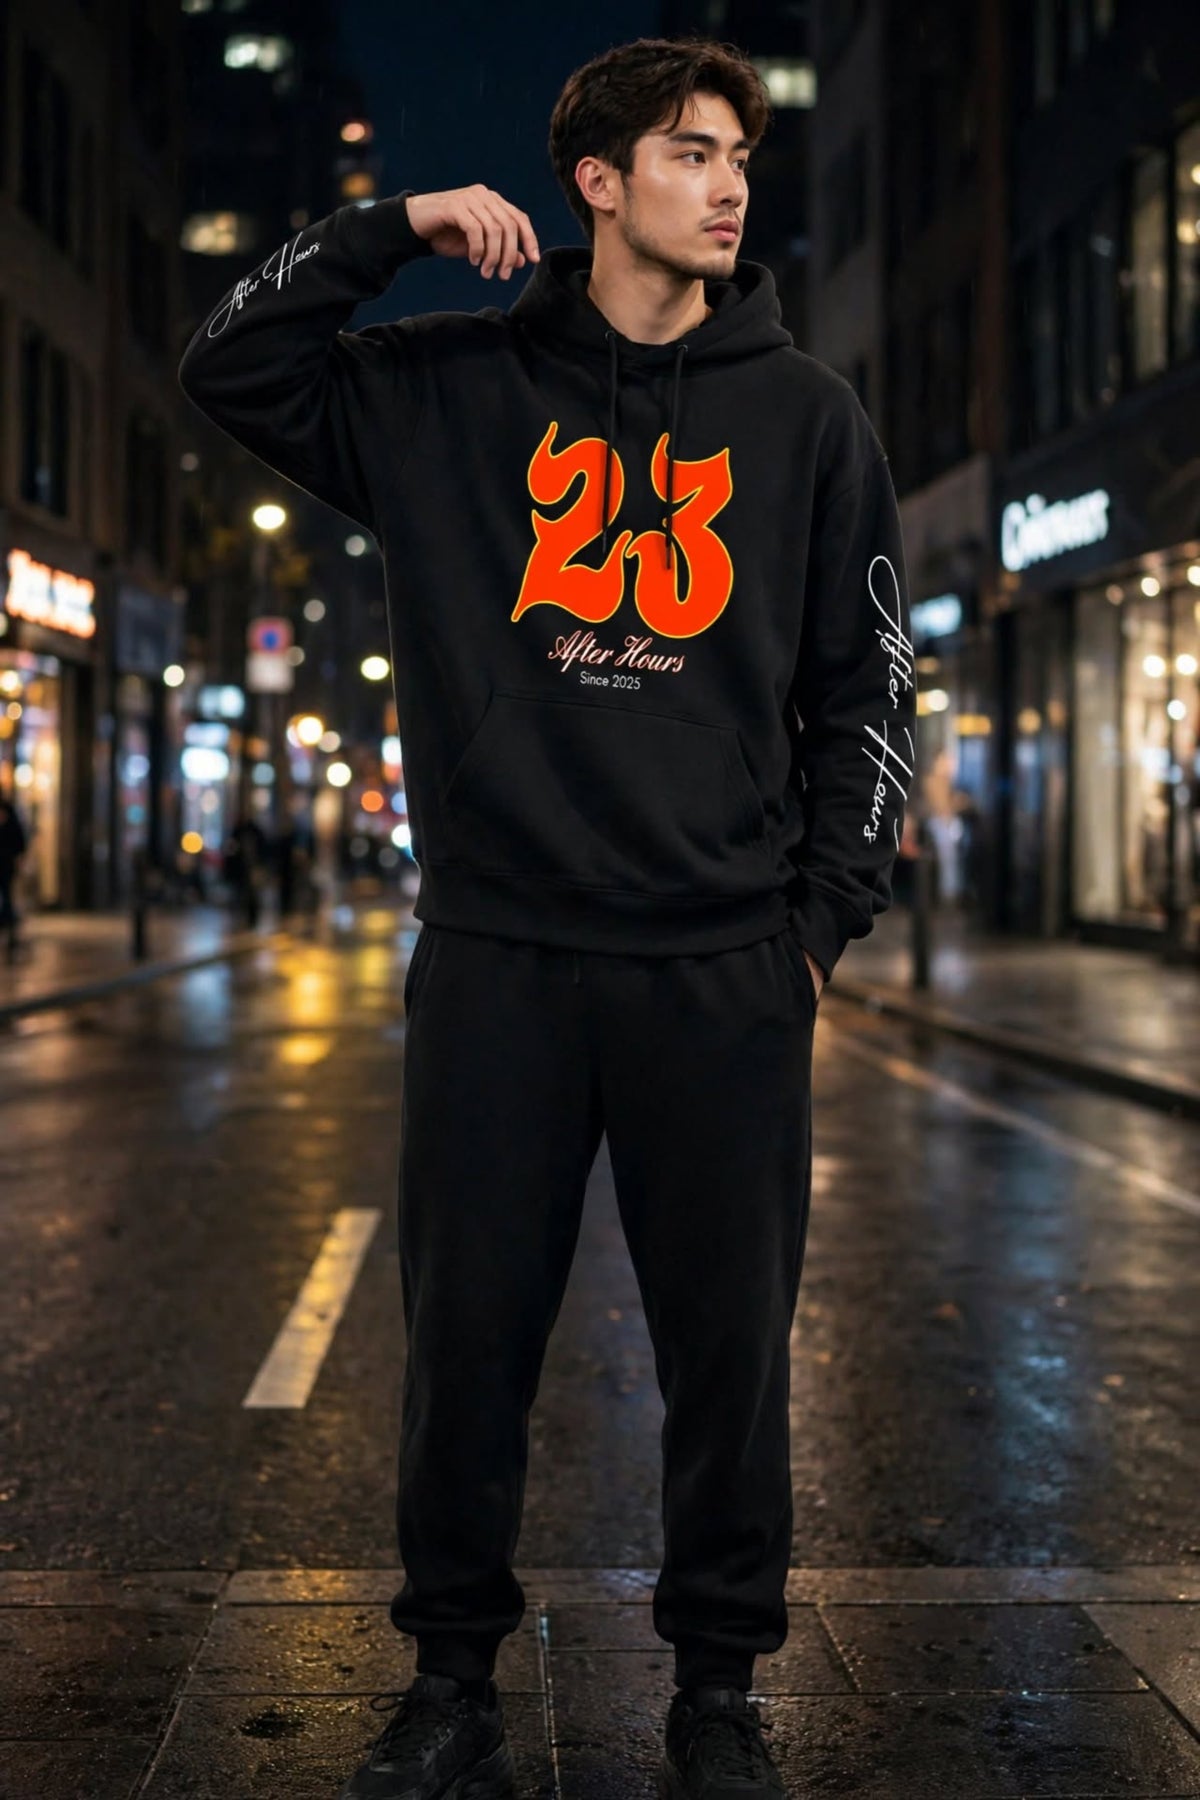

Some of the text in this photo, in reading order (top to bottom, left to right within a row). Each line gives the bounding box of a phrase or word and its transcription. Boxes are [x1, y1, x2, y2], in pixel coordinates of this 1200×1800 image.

[208, 231, 320, 337] After Hours
[511, 421, 733, 639] 23
[548, 630, 685, 673] After Hours
[579, 671, 641, 690] Since 2025
[861, 555, 915, 852] After Hours
